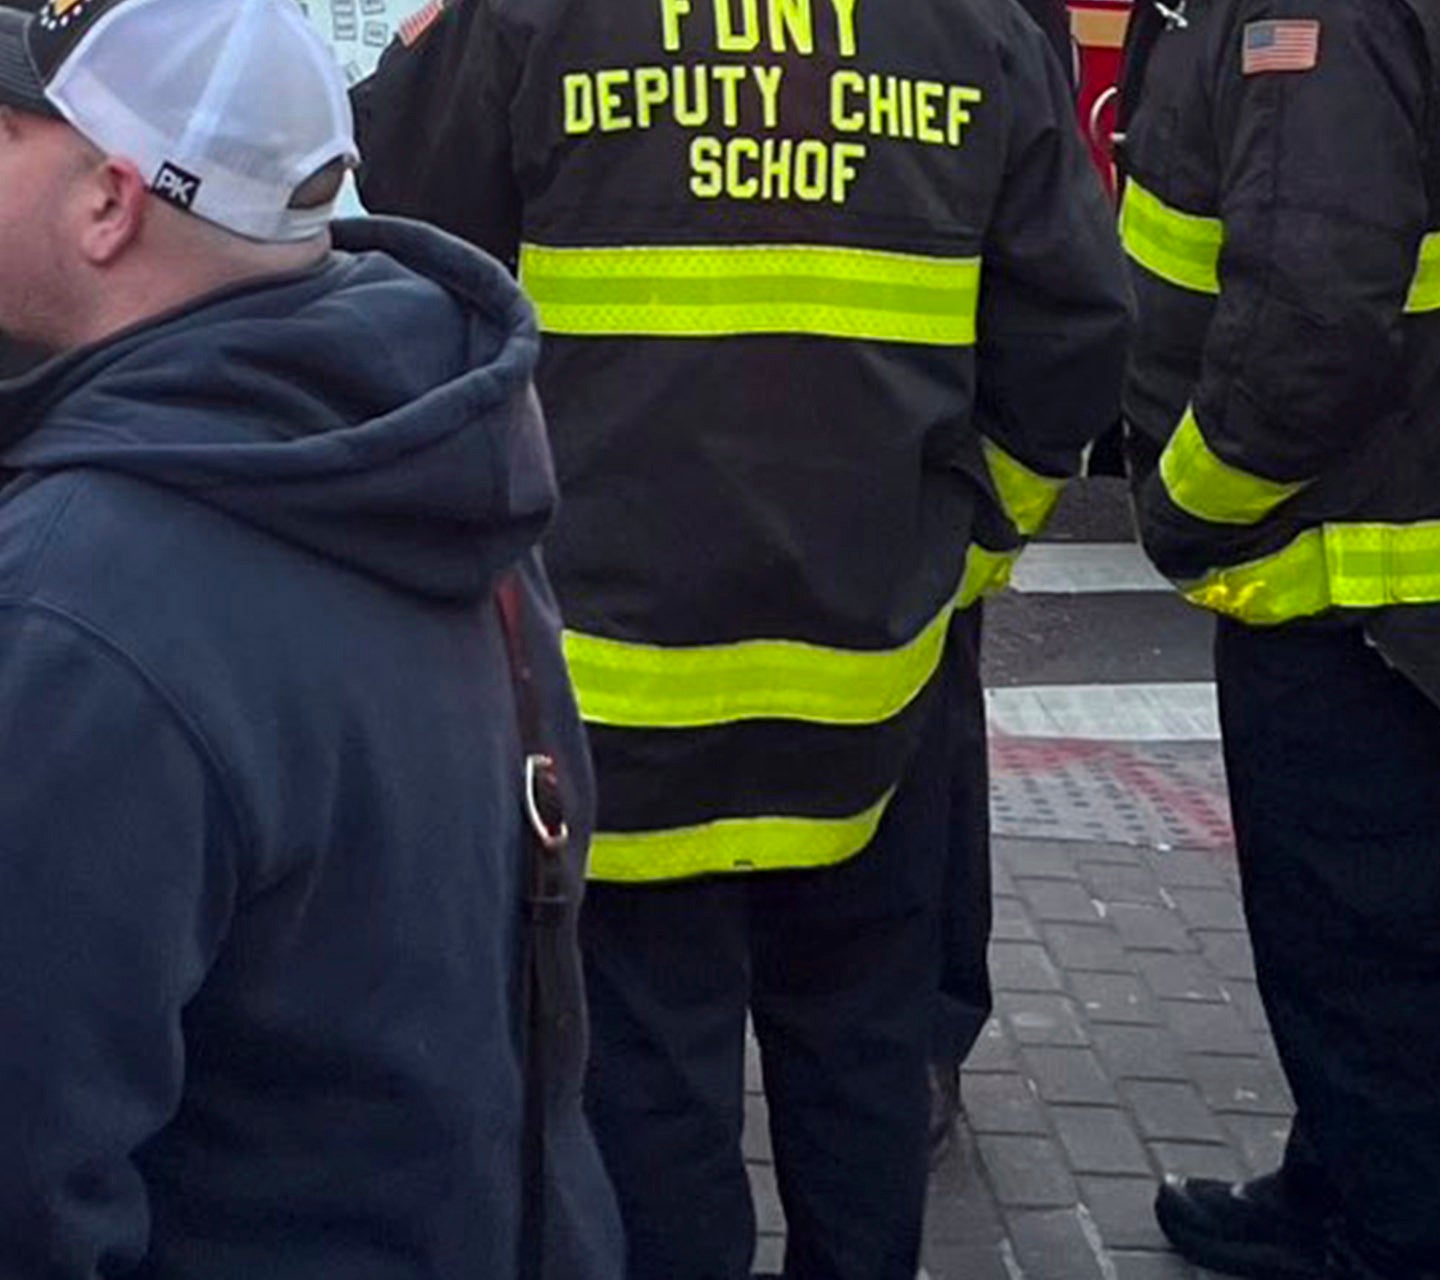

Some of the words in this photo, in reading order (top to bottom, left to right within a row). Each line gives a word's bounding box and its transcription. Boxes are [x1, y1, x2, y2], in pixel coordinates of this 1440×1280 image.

[562, 65, 782, 134] DEPUTY
[829, 70, 982, 146] CHIEF
[155, 166, 195, 203] PK
[689, 136, 867, 204] SCHOF
